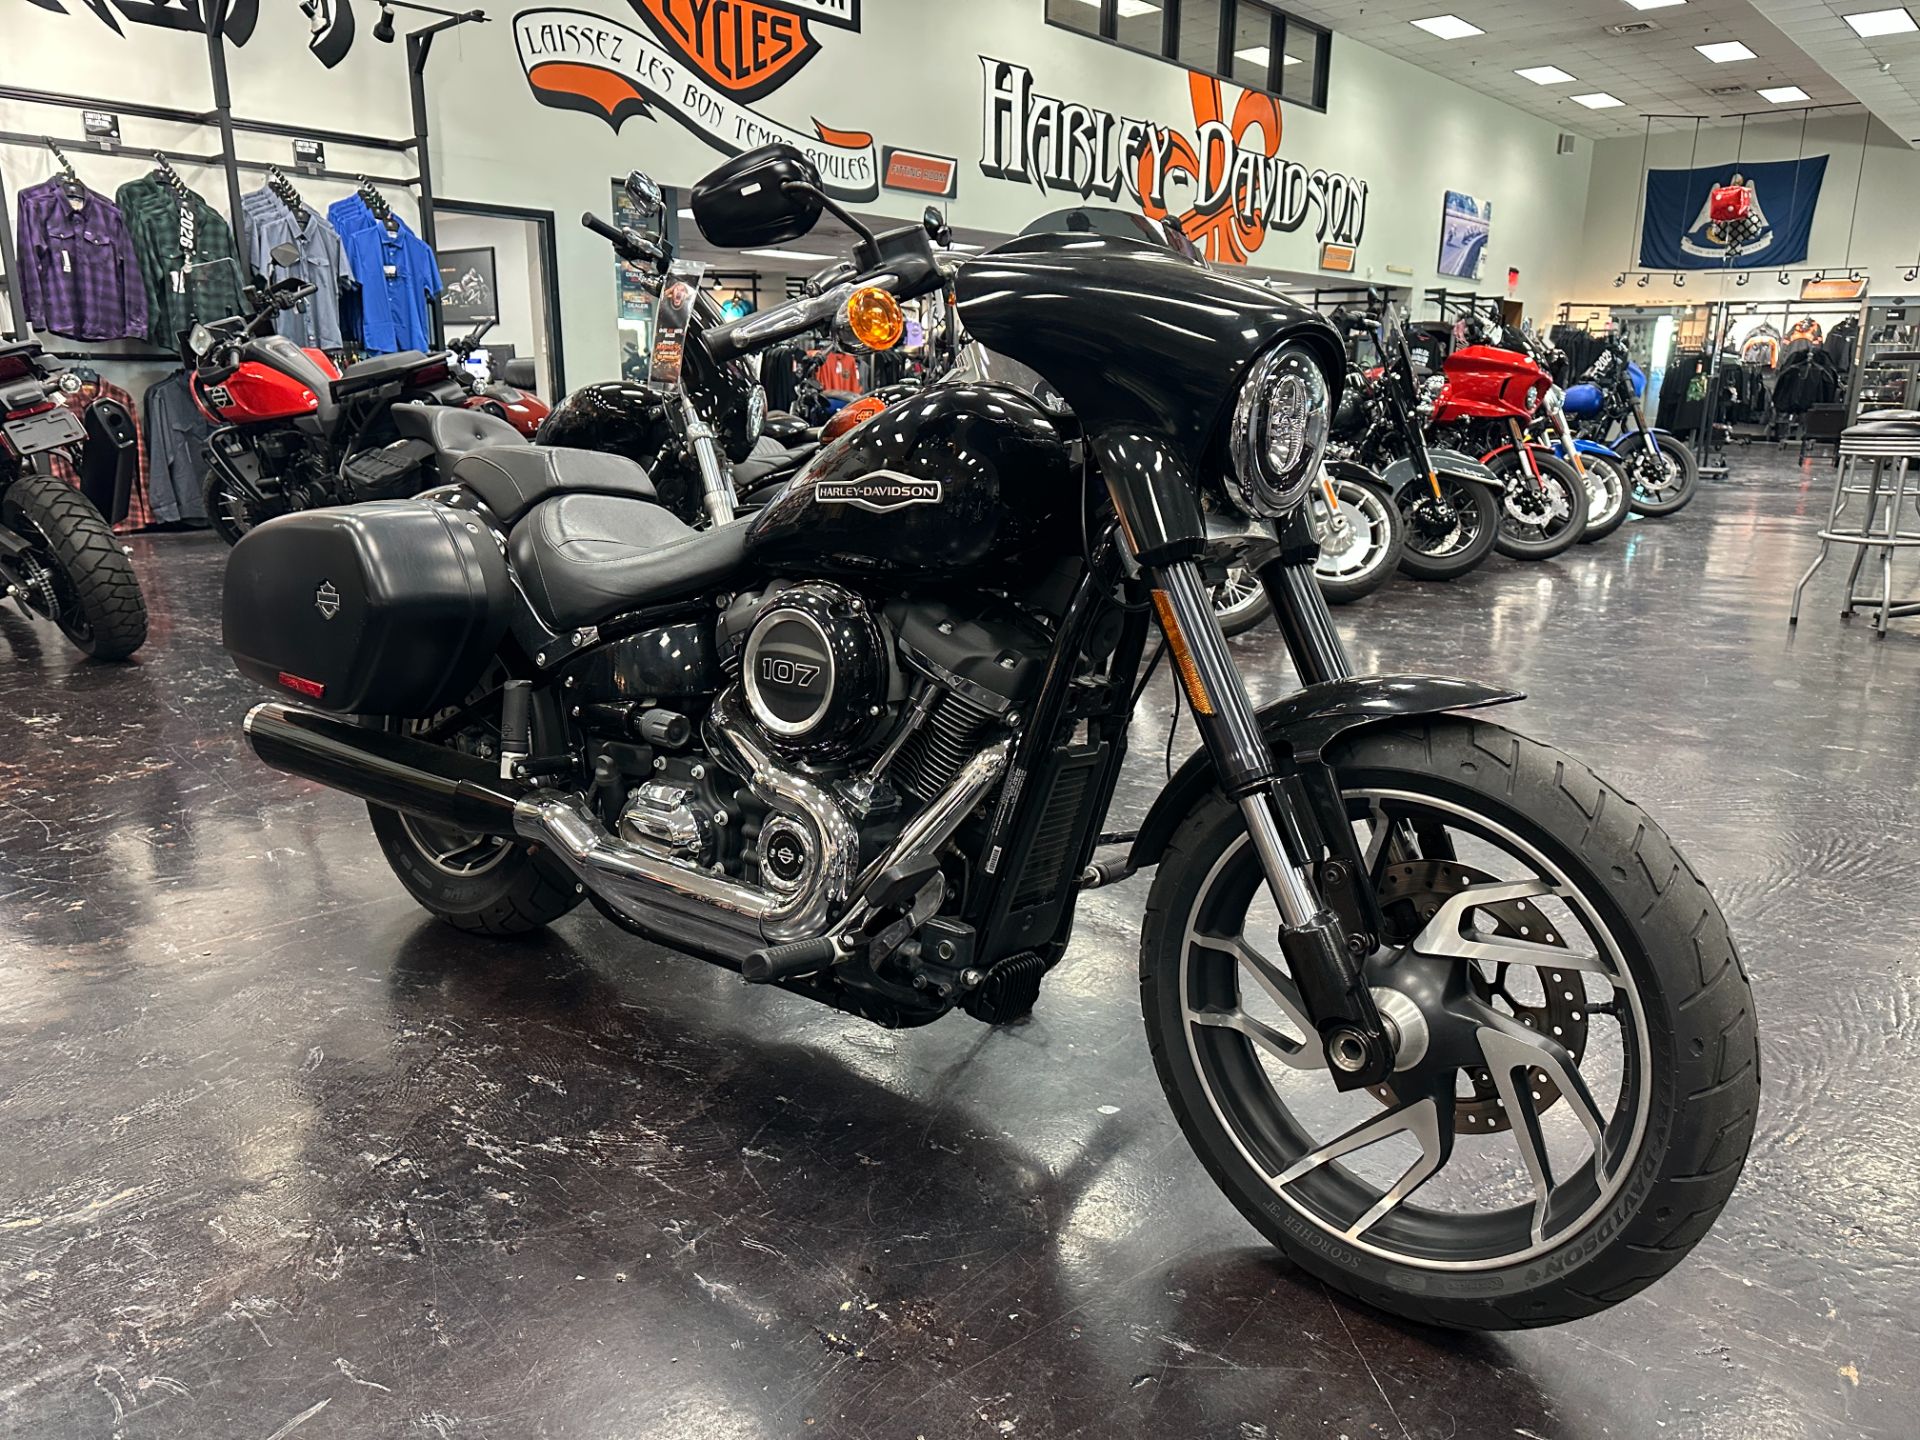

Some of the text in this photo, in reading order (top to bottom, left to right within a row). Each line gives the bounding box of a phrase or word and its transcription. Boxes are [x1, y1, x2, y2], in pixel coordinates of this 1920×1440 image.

[662, 0, 793, 80] CYCLES
[524, 24, 623, 63] LAISSEZ
[636, 49, 675, 92] LES
[682, 84, 725, 128] BON
[735, 115, 794, 148] TEM
[891, 164, 947, 183] FITTING ROOM
[180, 208, 194, 249] 2026
[820, 486, 934, 497] HARLEY-DAVIDSON
[763, 658, 820, 687] 107
[1284, 1215, 1361, 1267] SCORCHER
